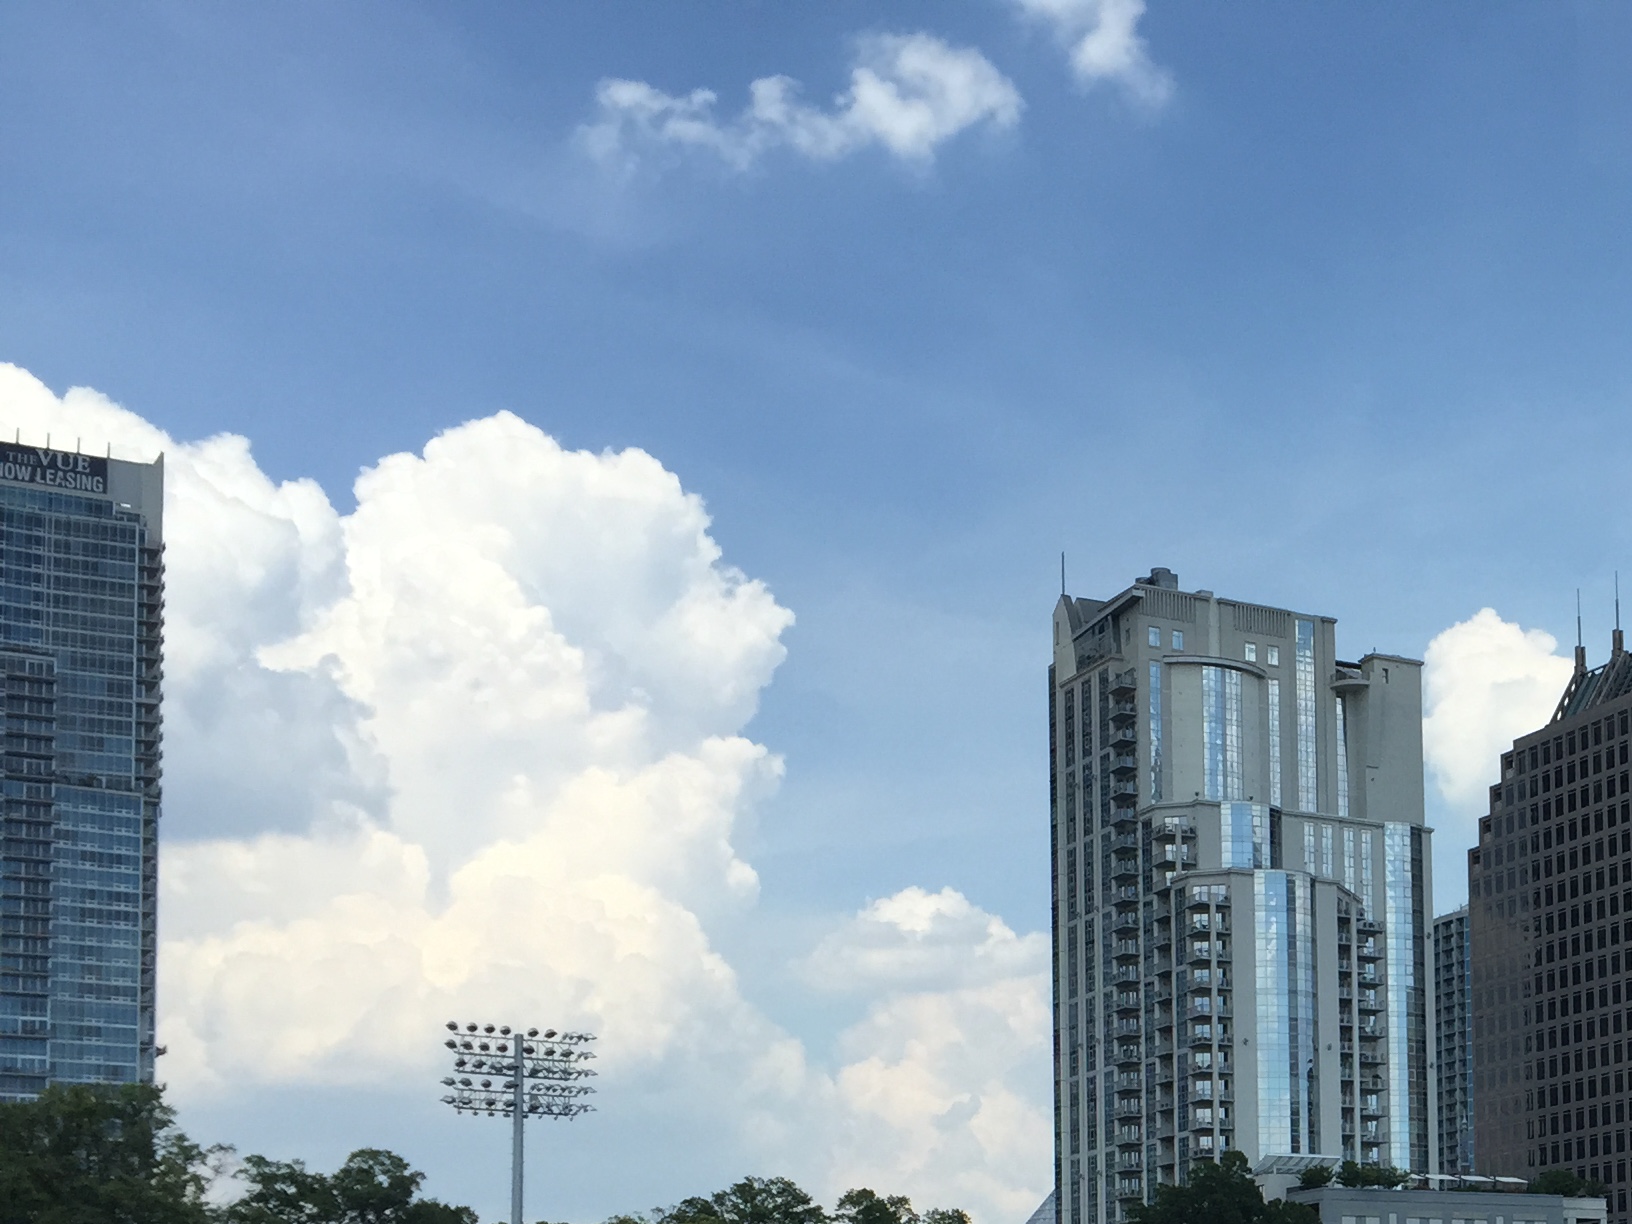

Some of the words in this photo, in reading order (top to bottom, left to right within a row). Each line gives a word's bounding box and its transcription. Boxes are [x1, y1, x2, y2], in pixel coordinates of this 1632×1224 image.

[5, 451, 38, 465] THE
[35, 449, 91, 473] VUE
[34, 467, 104, 493] LEASING
